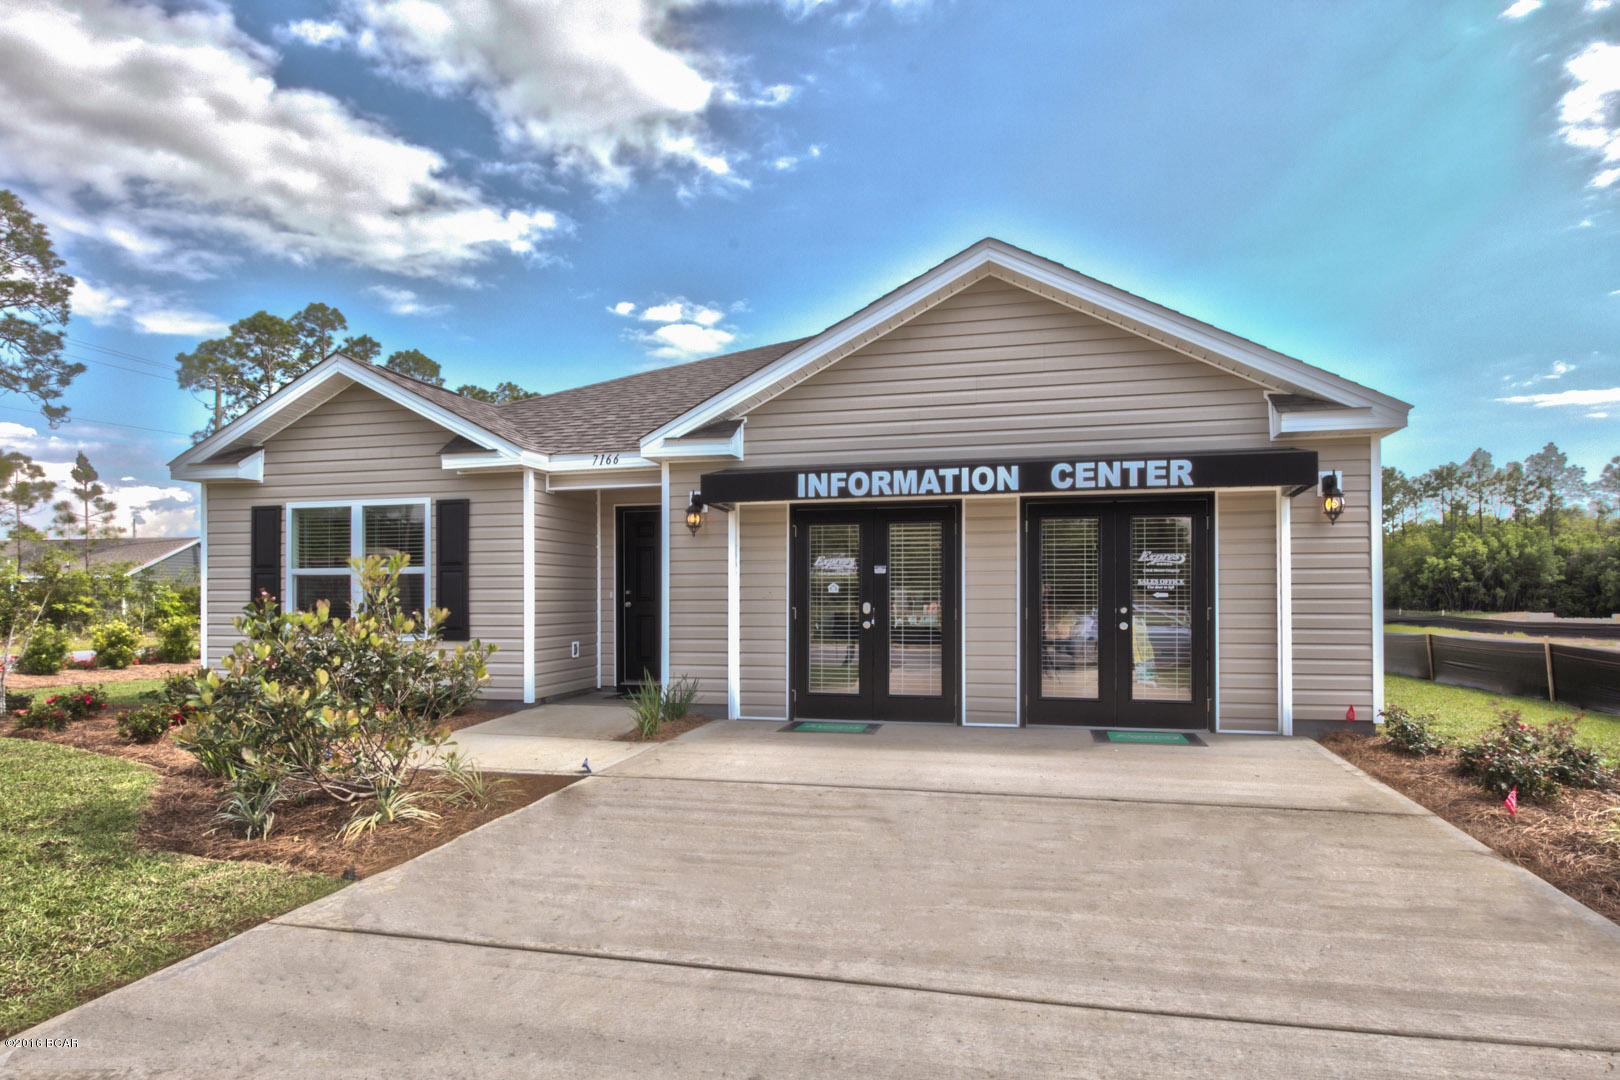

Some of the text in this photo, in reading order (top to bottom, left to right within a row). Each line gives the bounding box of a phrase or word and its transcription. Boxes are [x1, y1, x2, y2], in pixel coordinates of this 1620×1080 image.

[593, 453, 619, 466] 7166
[797, 459, 1193, 498] INFORMATION CENTER
[1138, 551, 1187, 566] Express
